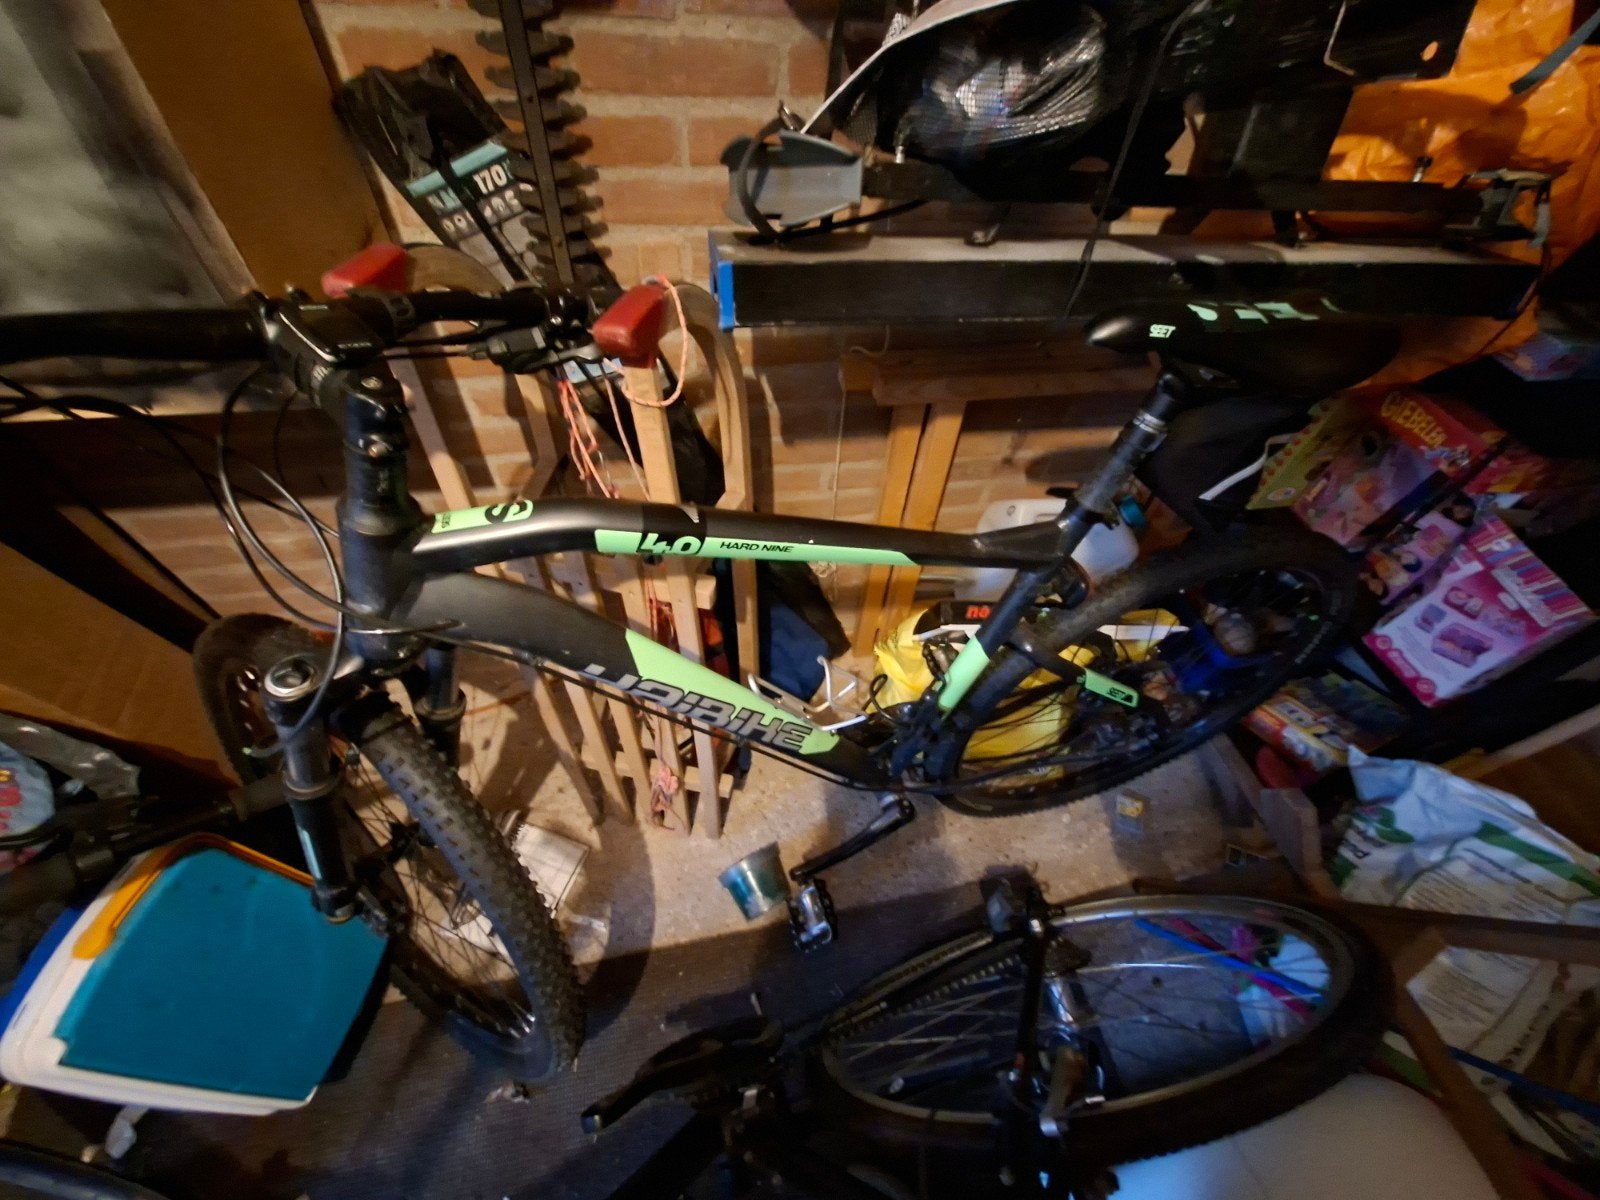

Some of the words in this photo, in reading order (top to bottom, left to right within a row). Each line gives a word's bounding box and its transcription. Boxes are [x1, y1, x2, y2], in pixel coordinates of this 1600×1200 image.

[472, 164, 508, 195] 170
[719, 541, 759, 551] HARD
[761, 544, 794, 553] NINE
